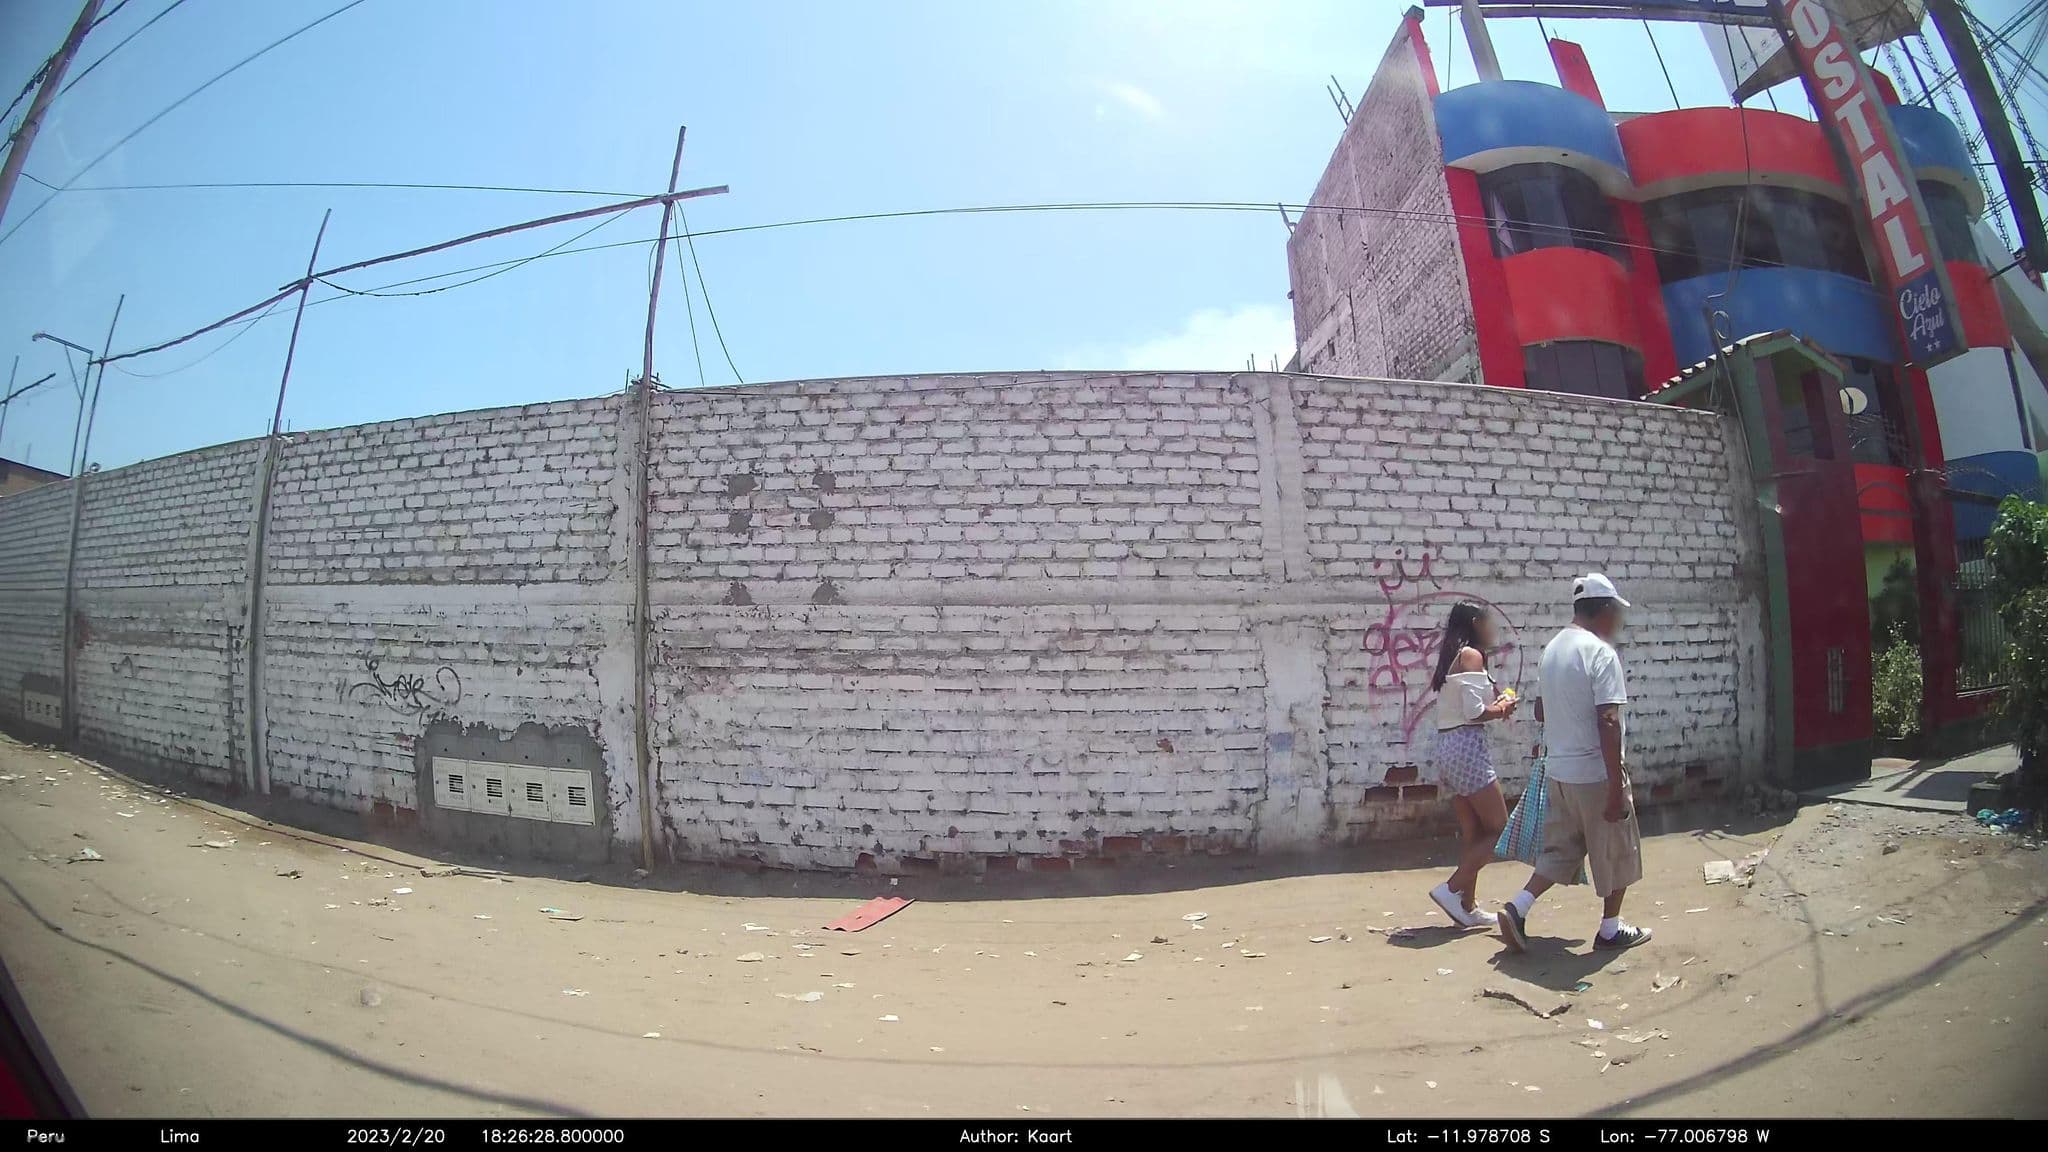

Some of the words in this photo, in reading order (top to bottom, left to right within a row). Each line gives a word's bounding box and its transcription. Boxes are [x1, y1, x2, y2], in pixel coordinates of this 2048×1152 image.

[1783, 0, 1926, 278] OSTAL
[1899, 284, 1941, 320] Cielo
[1910, 307, 1944, 340] Azul
